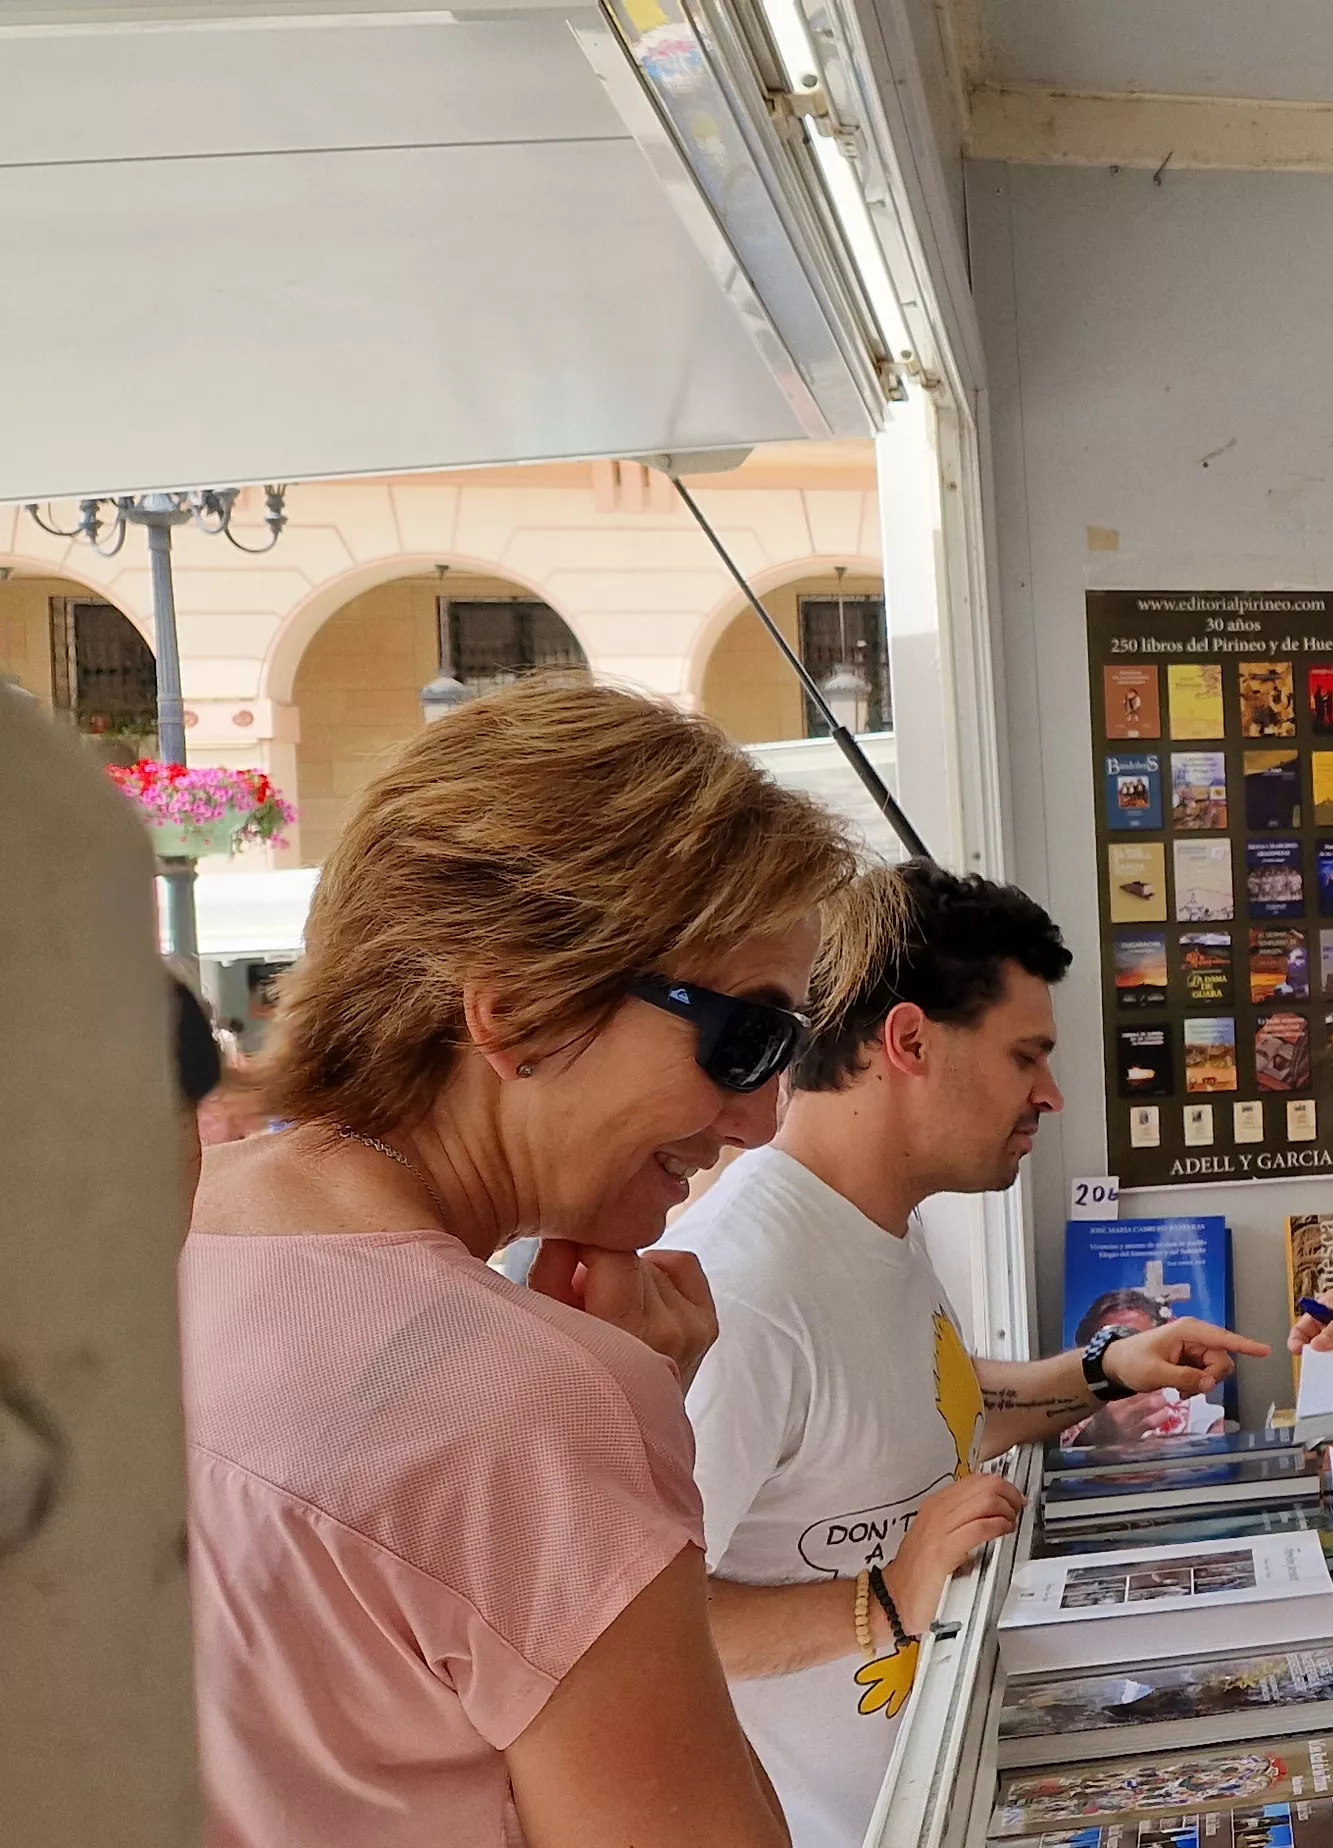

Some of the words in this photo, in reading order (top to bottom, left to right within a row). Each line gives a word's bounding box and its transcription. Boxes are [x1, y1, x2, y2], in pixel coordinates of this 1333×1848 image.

[1138, 596, 1326, 615] www.editorialpirineo.com
[1206, 618, 1224, 632] 30
[1227, 617, 1261, 632] años
[1111, 639, 1138, 653] 250
[1141, 637, 1183, 652] libros
[1187, 637, 1209, 652] del
[1212, 638, 1266, 652] Pirineo
[1269, 641, 1278, 655] y
[1281, 637, 1298, 651] de
[1170, 1156, 1235, 1176] ADELL
[1239, 1154, 1252, 1171] Y
[1257, 1150, 1333, 1170] GARCIA
[826, 1510, 918, 1545] DON'T
